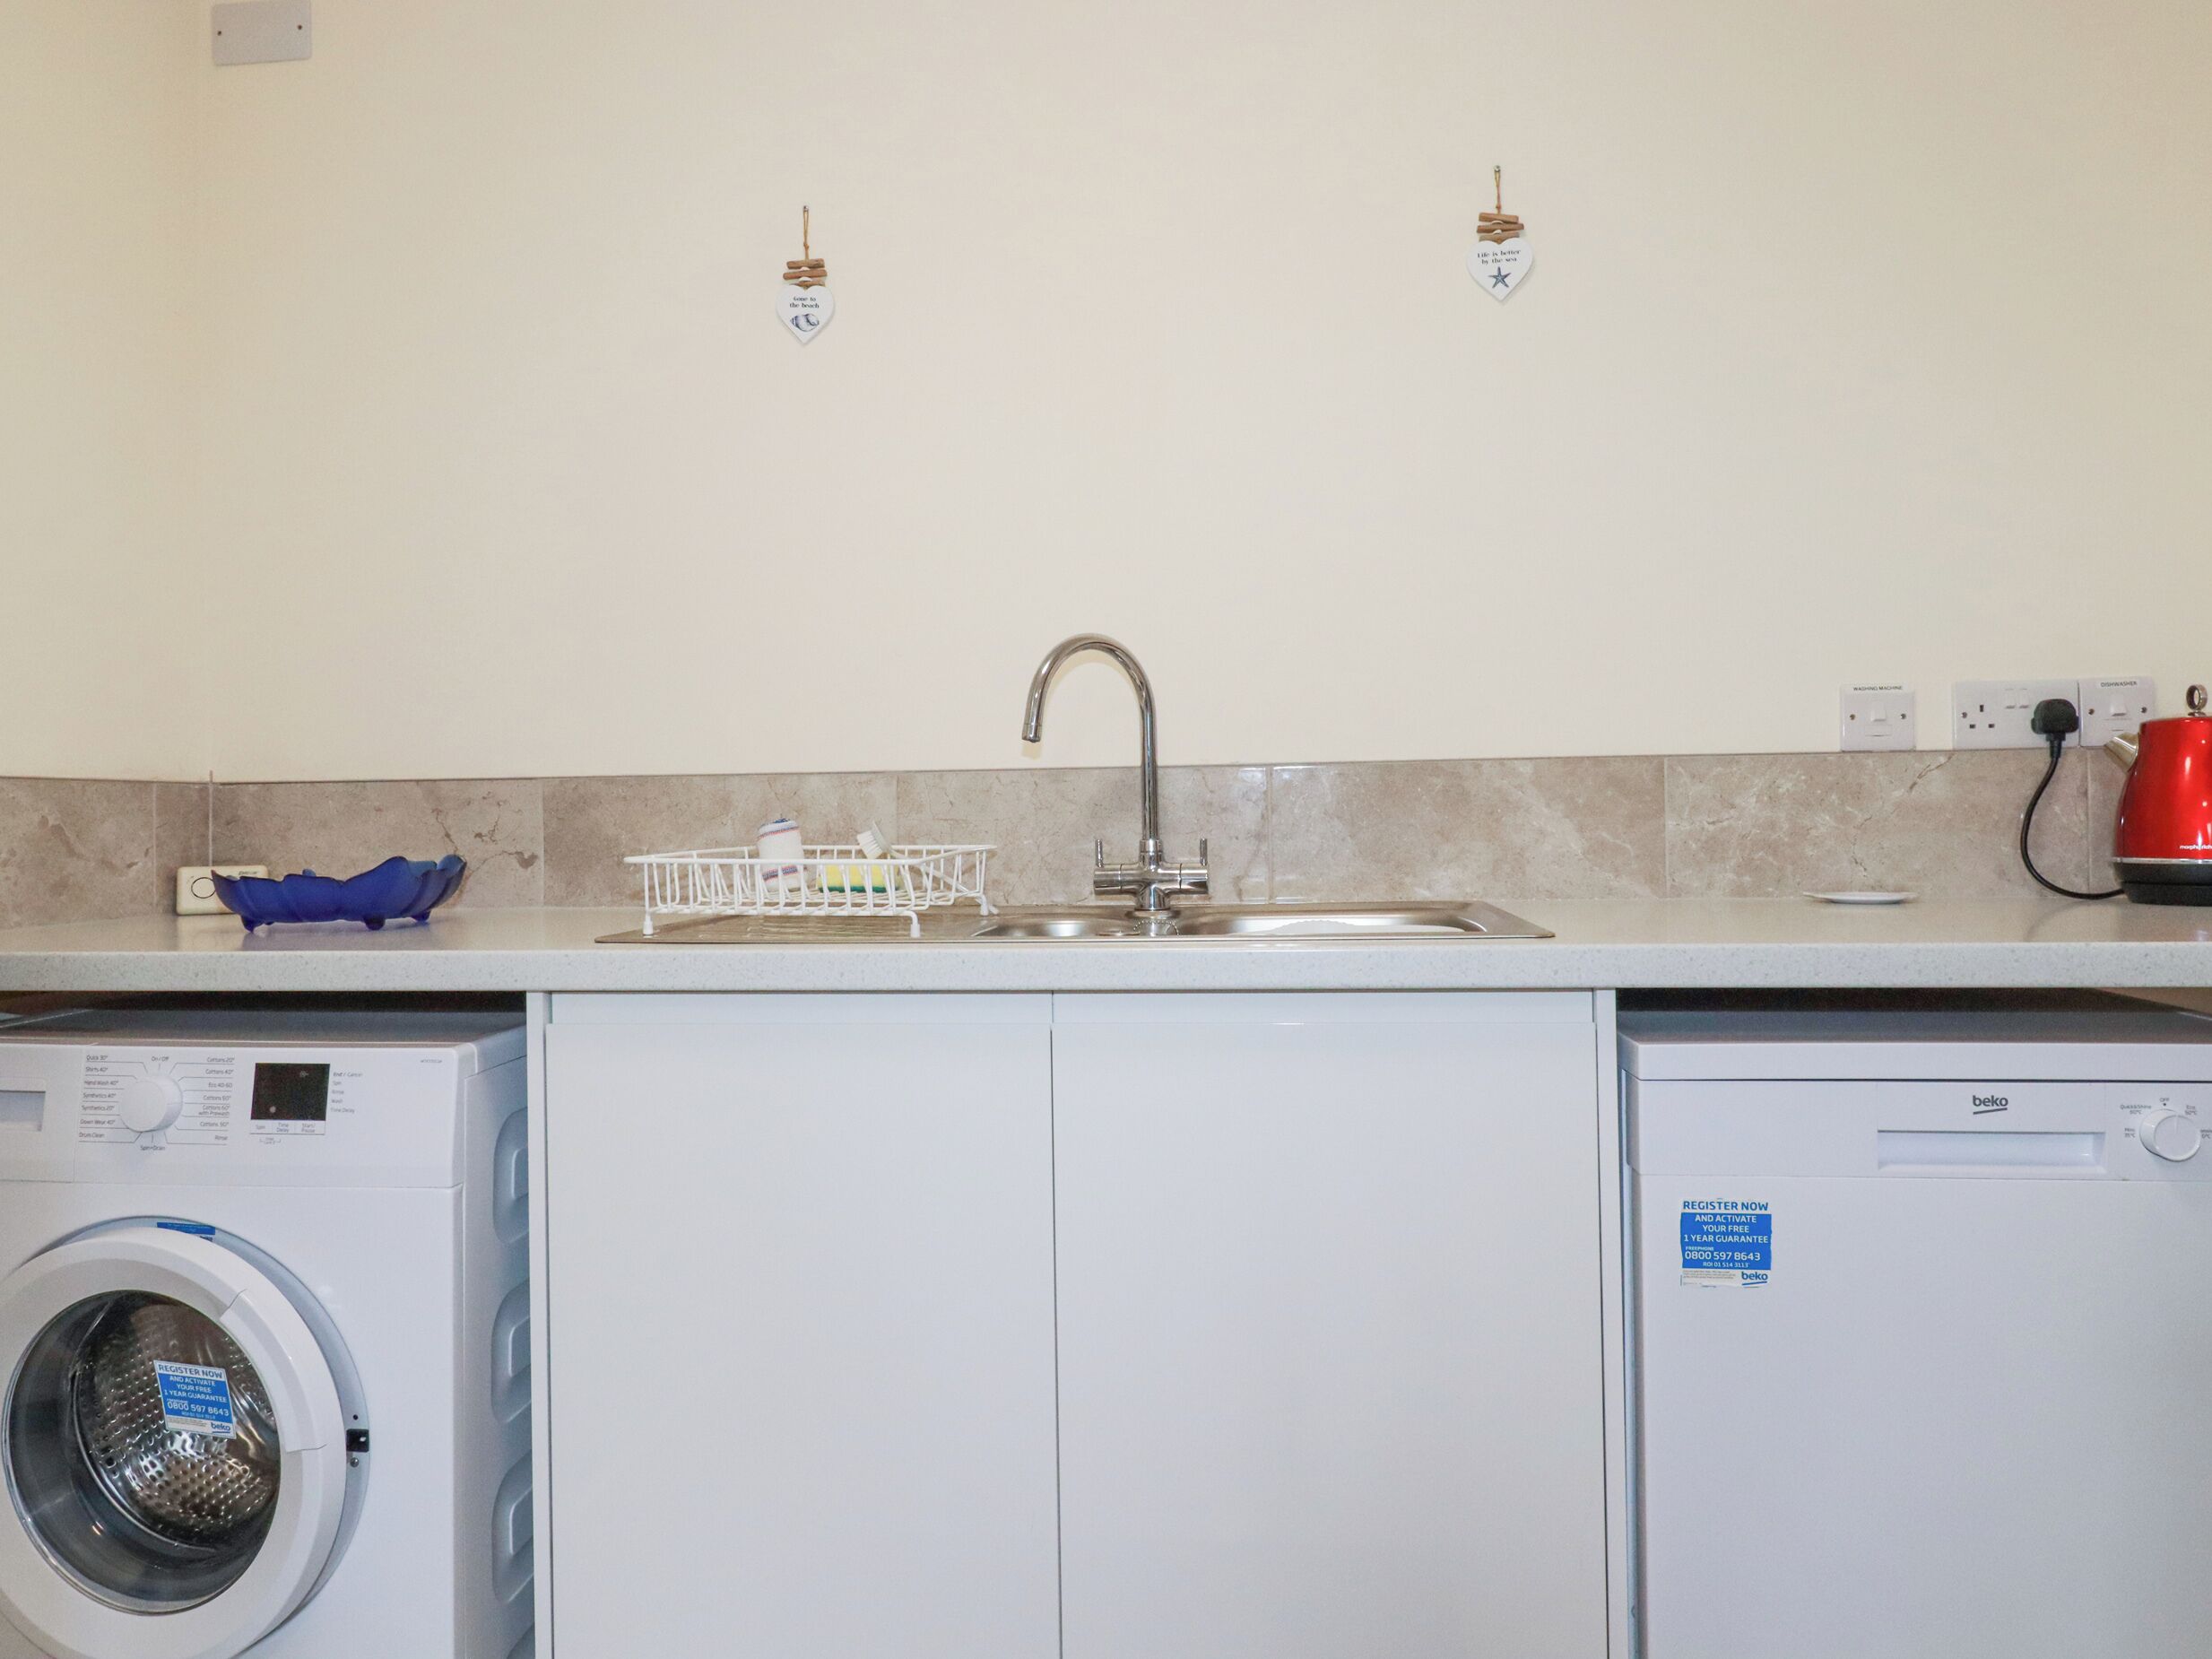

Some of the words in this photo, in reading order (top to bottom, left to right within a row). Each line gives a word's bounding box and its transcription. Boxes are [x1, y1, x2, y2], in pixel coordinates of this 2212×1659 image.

[1973, 1095, 2008, 1107] beko
[1683, 1201, 1738, 1211] REGISTER
[1741, 1202, 1768, 1211] NOW
[1715, 1215, 1757, 1223] ACTIVATE
[1715, 1235, 1768, 1243] GUARANTEE
[1685, 1251, 1711, 1259] 0800
[1713, 1252, 1731, 1260] 597
[1734, 1252, 1760, 1261] 8643
[1741, 1272, 1768, 1281] beko
[158, 1364, 200, 1376] REGISTER
[203, 1370, 222, 1378] NOW
[185, 1377, 215, 1386] ACTIVATE
[187, 1392, 228, 1403] GUARANTEE
[168, 1402, 188, 1411] 0800
